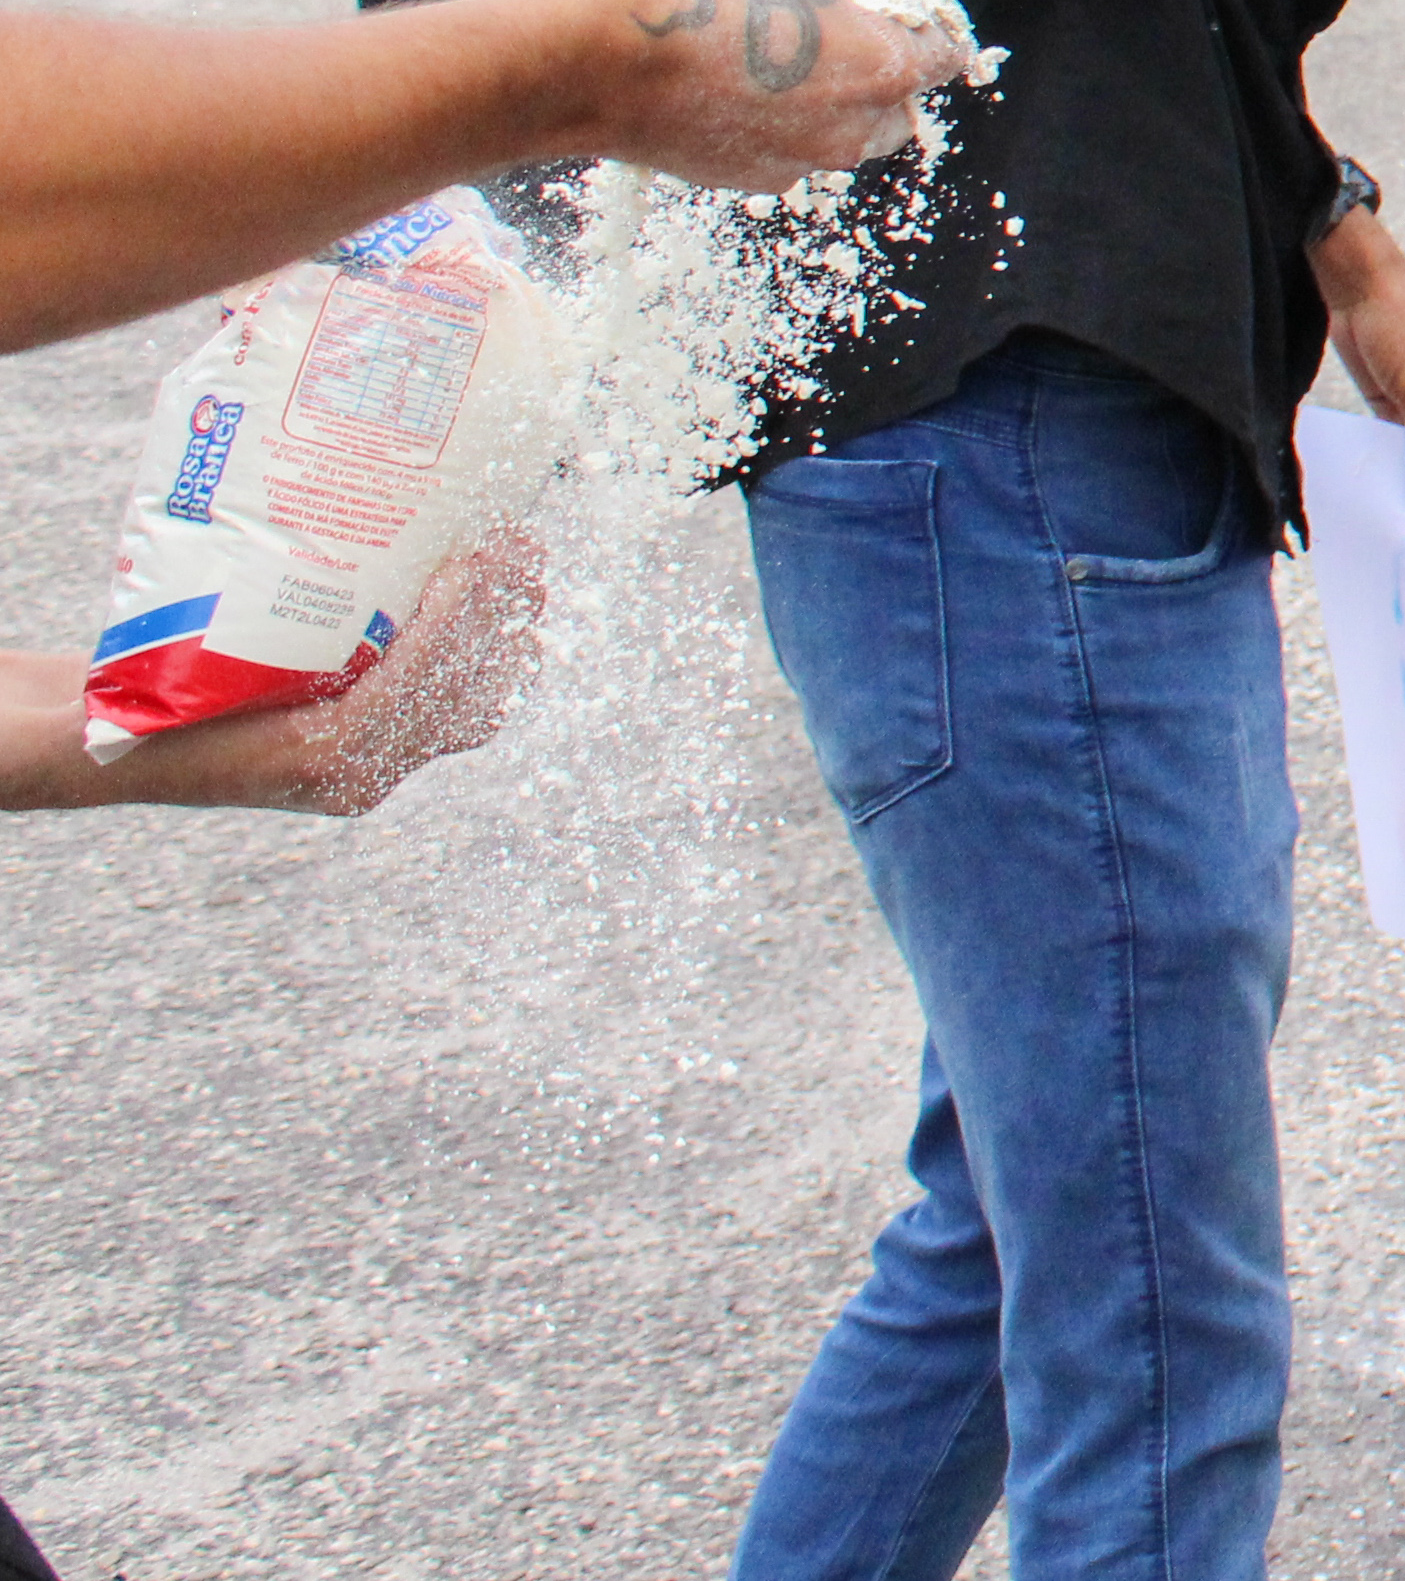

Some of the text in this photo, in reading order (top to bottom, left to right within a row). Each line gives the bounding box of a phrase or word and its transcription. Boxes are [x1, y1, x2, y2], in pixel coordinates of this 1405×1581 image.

[167, 436, 212, 519] Rosa
[184, 402, 245, 526] Branca
[297, 495, 325, 510] FÓLICO
[280, 573, 355, 602] FAB060423
[268, 602, 341, 631] M2T2L0423
